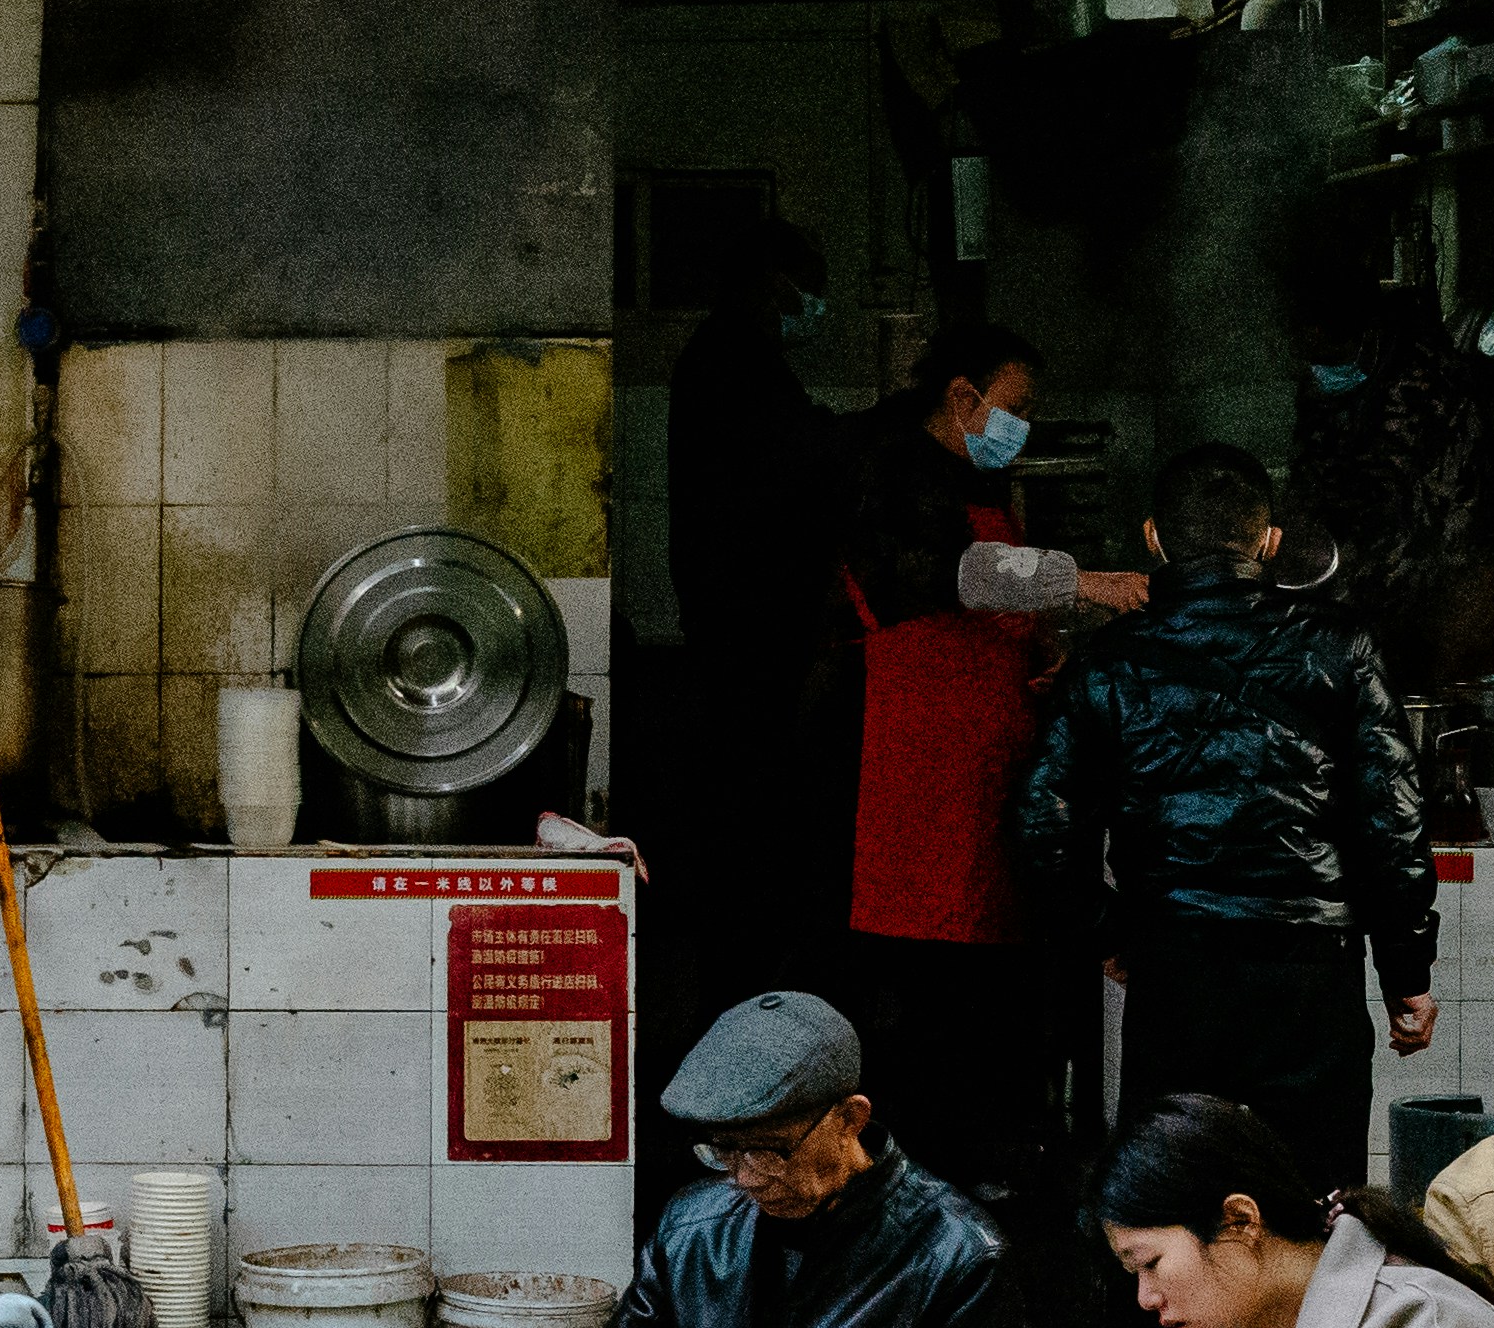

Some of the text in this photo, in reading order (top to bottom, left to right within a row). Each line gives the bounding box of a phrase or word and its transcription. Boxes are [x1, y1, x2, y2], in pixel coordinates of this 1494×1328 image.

[371, 876, 558, 893] 请在一米线以外等候
